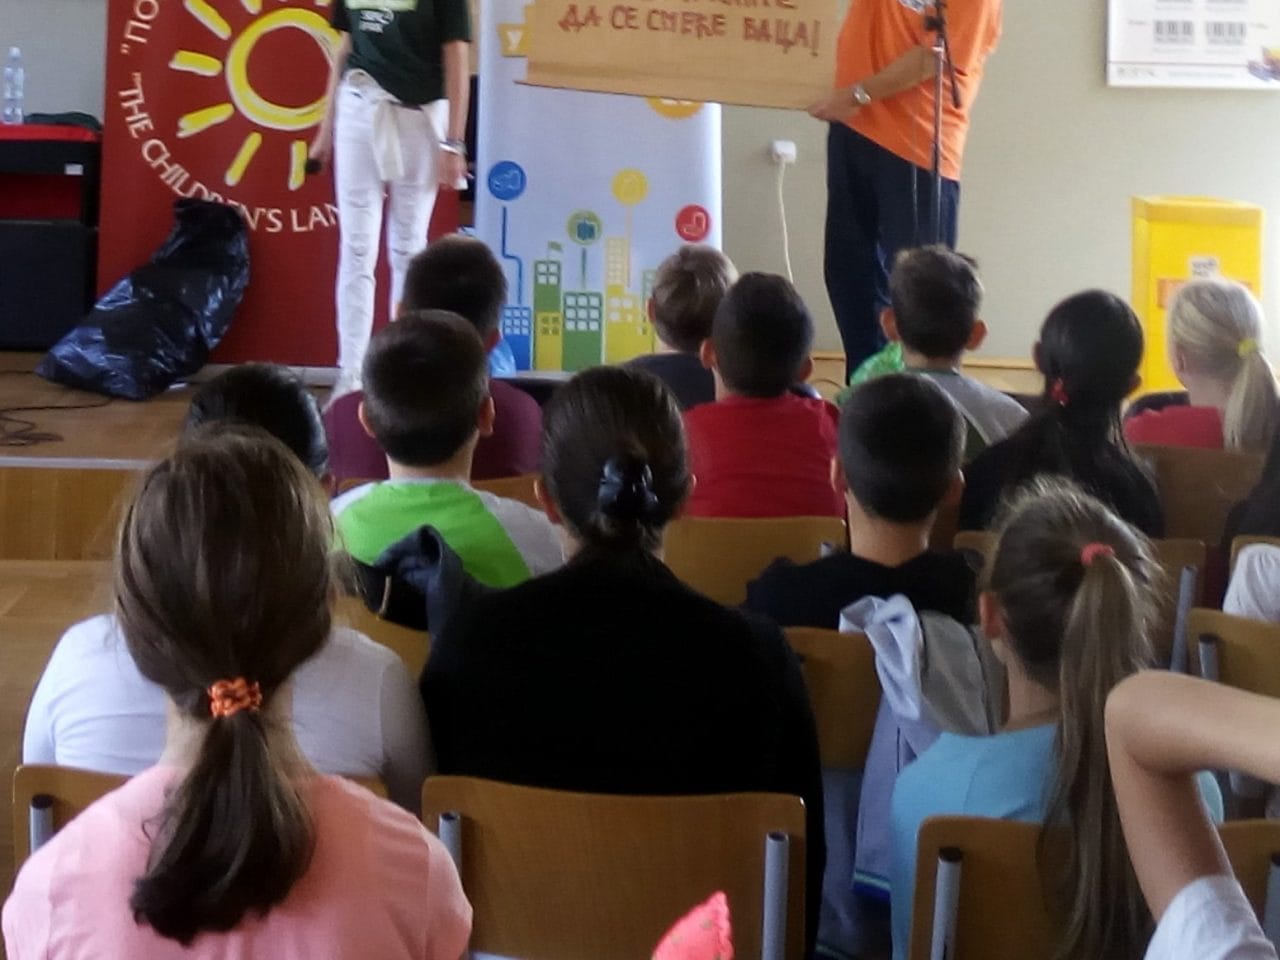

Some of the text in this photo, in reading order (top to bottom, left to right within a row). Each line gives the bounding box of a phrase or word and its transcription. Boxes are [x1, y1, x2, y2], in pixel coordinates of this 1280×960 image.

[557, 4, 602, 33] ДА
[610, 5, 640, 30] СЕ
[742, 16, 820, 57] БАЦА!
